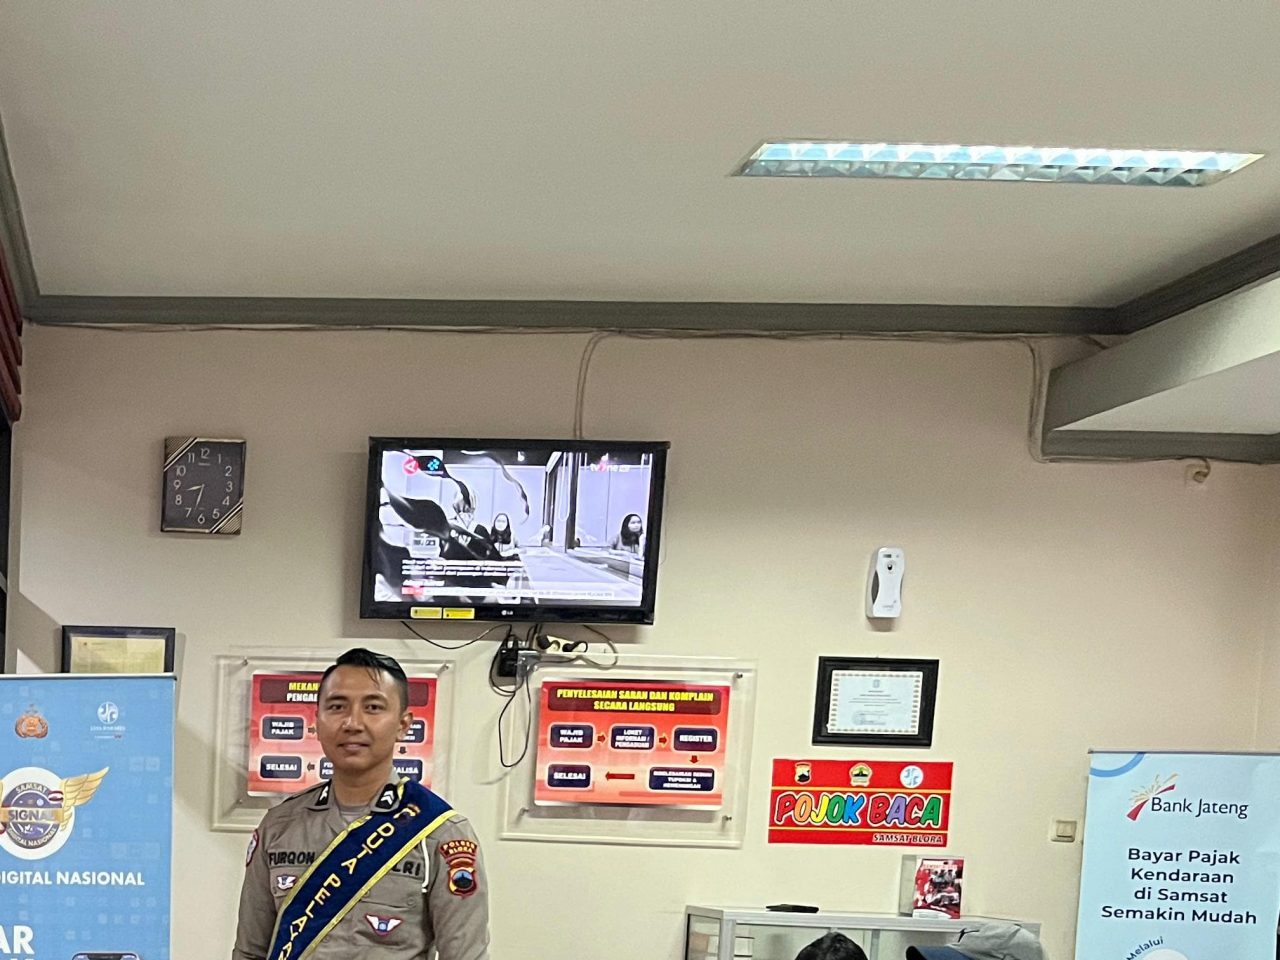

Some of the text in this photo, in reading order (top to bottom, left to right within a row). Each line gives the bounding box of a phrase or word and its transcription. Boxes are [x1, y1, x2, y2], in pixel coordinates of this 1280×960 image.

[188, 452, 195, 463] 11
[200, 447, 210, 459] 12
[218, 453, 222, 464] 1
[175, 464, 186, 476] 10
[225, 465, 232, 477] 2
[173, 479, 181, 490] 9
[226, 481, 233, 492] 3
[175, 494, 182, 505] 8
[222, 496, 230, 506] 4
[185, 507, 192, 518] 7
[212, 508, 220, 519] 5
[197, 513, 205, 524] 6
[288, 682, 319, 691] MEKAN
[556, 688, 714, 702] PENYELESAIAN SARAN DAN KOMPLAIN
[593, 701, 675, 712] SECARA LANGSUNG
[679, 735, 713, 743] REGISTER
[553, 772, 586, 780] SELESAI
[775, 793, 943, 827] POJOK BACA
[1150, 796, 1249, 820] Bank Jateng
[874, 834, 909, 842] SAMSAT
[340, 822, 395, 875] DUTA
[1128, 848, 1241, 866] Bayar Pajak
[56, 871, 145, 886] NASIONAL
[1130, 868, 1234, 884] Kendaraan
[1134, 887, 1228, 903] di Samsat
[1101, 905, 1257, 924] Semakin Mudah
